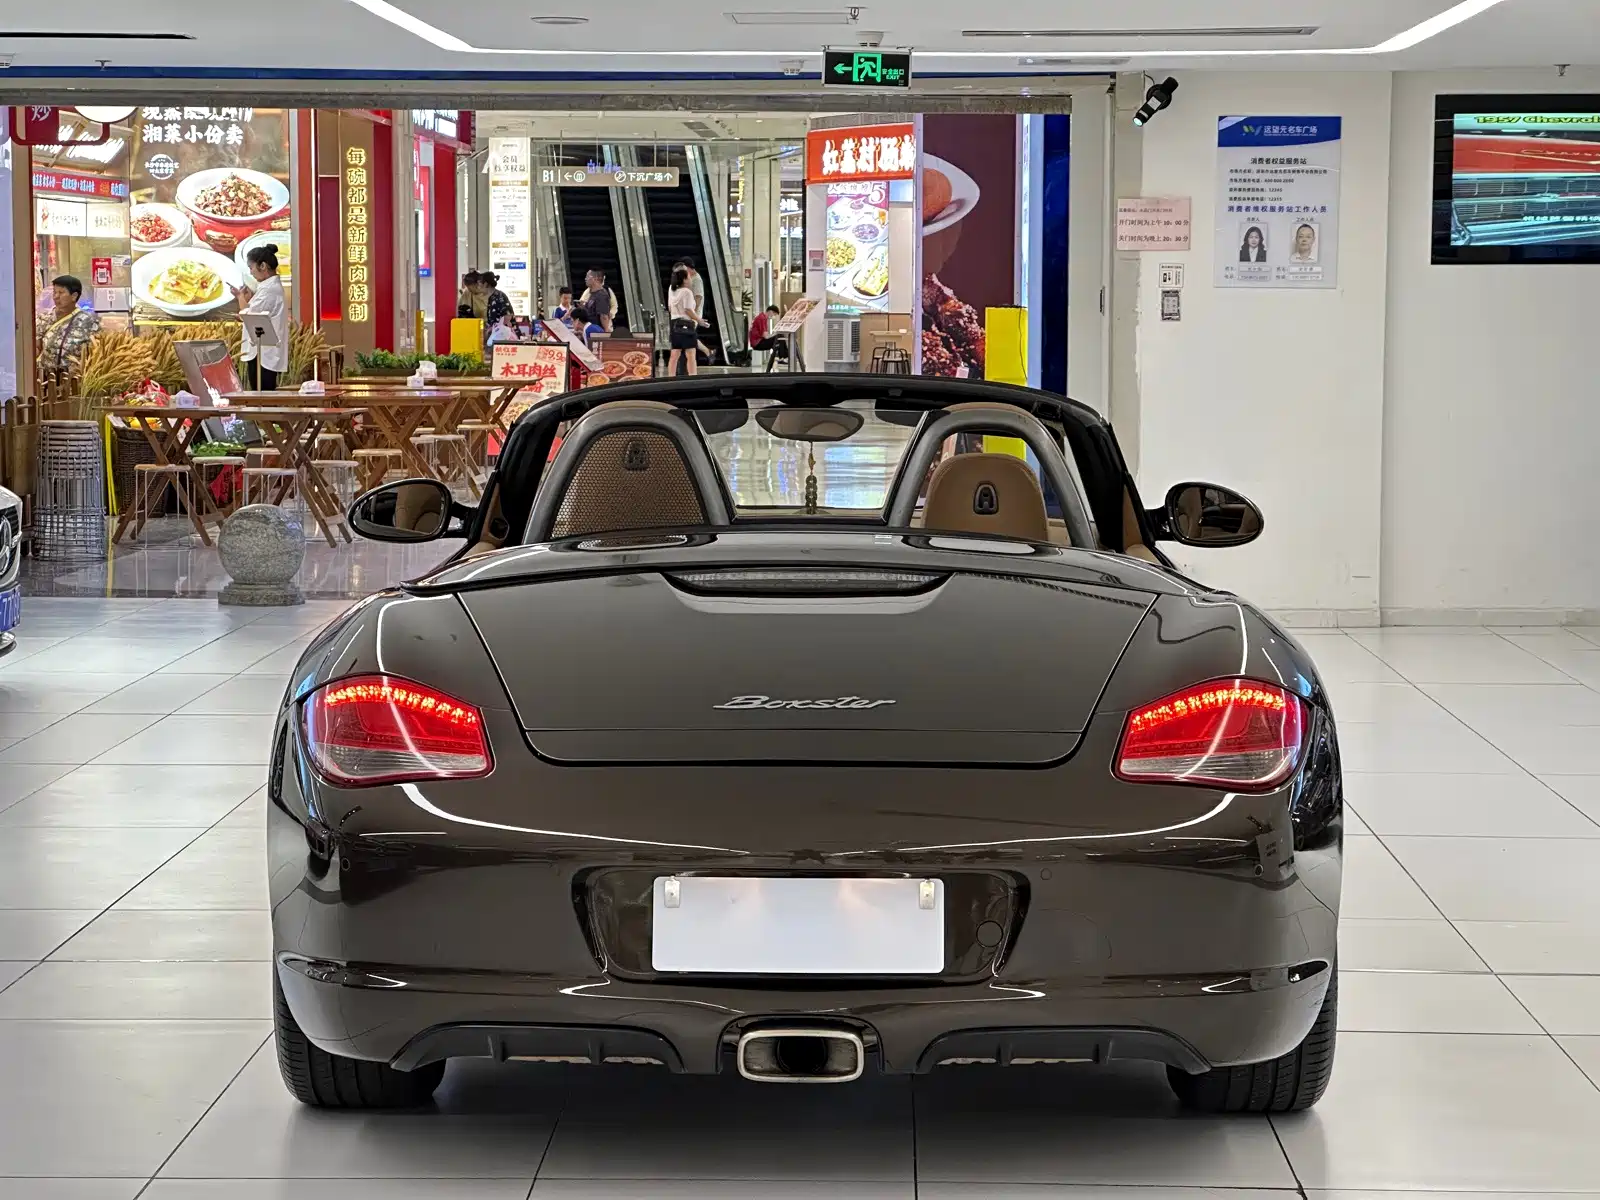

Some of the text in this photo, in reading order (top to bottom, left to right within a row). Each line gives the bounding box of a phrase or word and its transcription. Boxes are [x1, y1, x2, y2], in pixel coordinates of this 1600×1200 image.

[1474, 115, 1600, 124] 1957 Chevrol
[142, 123, 244, 145] 湘菜小份卖
[1263, 125, 1318, 134] 远望元名车广场
[1250, 157, 1307, 165] 消费者权益服务站
[542, 170, 554, 183] B1
[627, 172, 664, 182] 下沉广场
[1227, 205, 1328, 213] 消费者维权服务站工作人员
[347, 147, 368, 322] 每碗都是新鲜肉烧制
[500, 362, 557, 378] 木耳肉丝
[712, 695, 897, 709] Boxster
